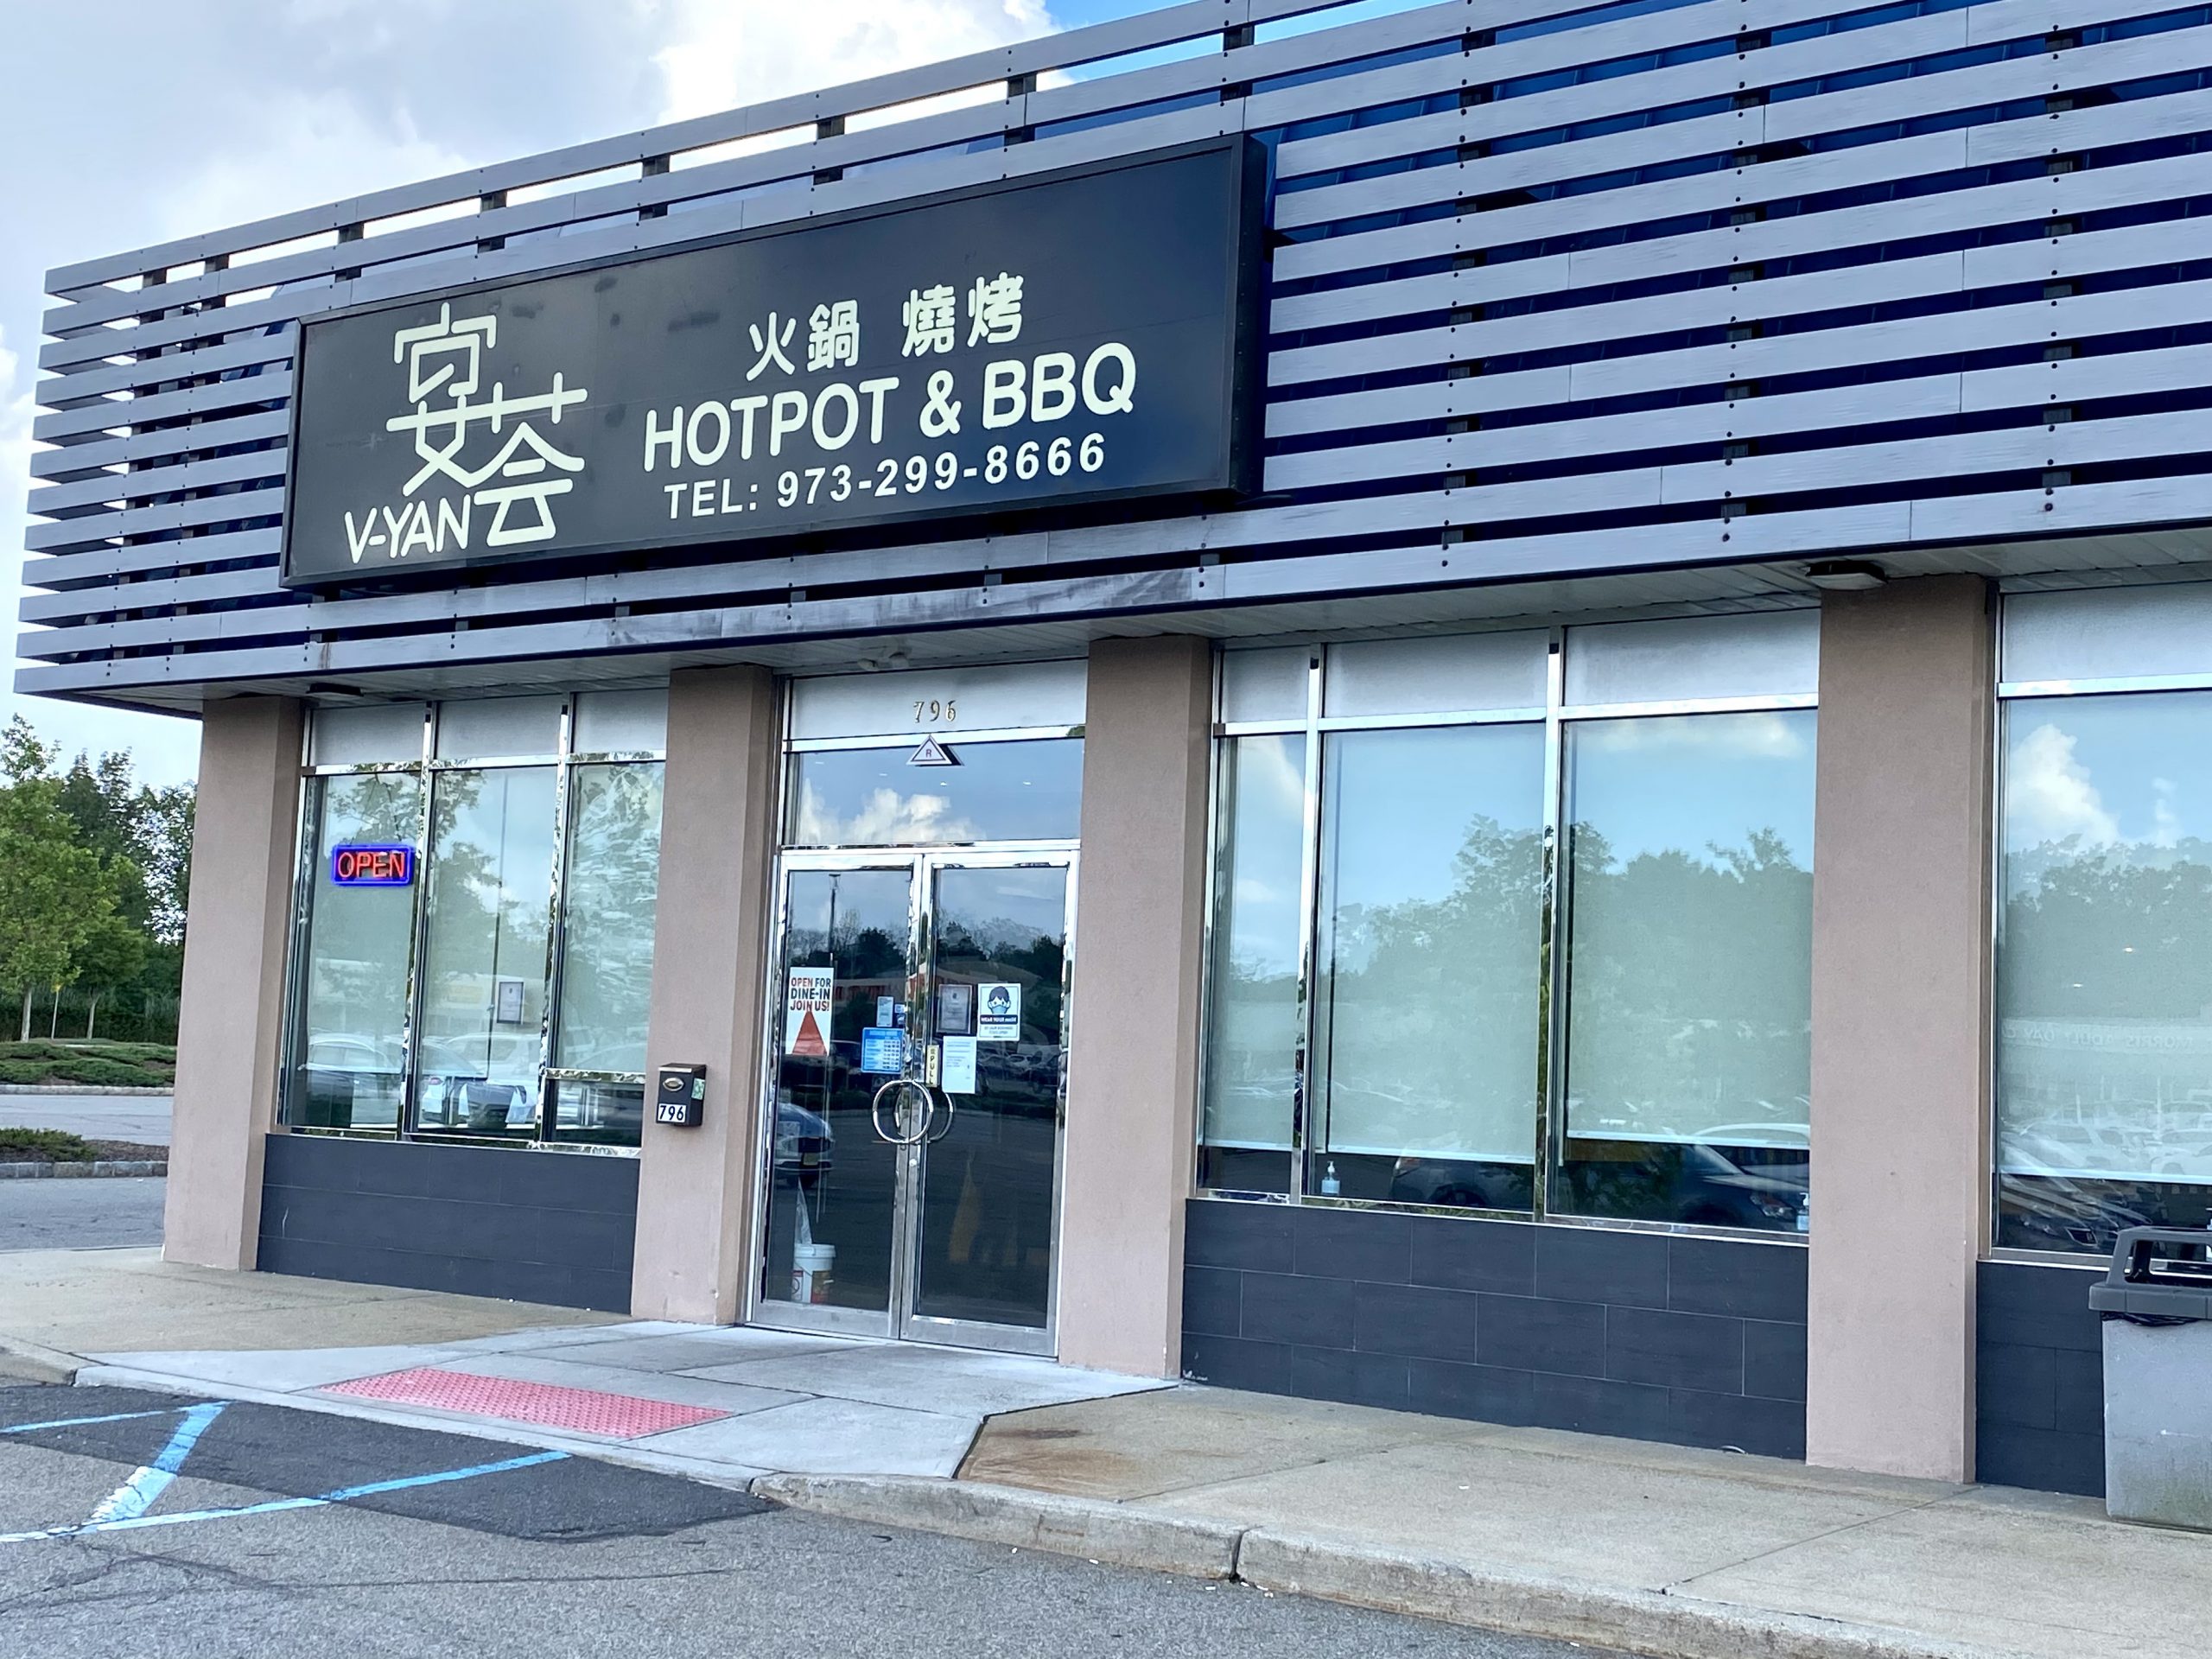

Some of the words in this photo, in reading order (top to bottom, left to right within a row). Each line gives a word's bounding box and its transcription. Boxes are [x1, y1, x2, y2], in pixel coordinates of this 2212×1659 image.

[747, 300, 860, 380] 火鍋
[901, 272, 1024, 358] 燒烤
[644, 378, 899, 471] HOTPOT
[919, 371, 962, 438] &
[982, 343, 1136, 430] BBQ
[664, 477, 758, 518] TEL:
[777, 433, 1104, 507] 973-299-8666
[345, 494, 471, 563] V-YAN
[913, 700, 957, 723] 796
[338, 851, 405, 878] OPEN
[791, 977, 814, 987] OPEN
[815, 977, 831, 988] FOR
[791, 988, 830, 1001] DINE-IN
[790, 1000, 813, 1011] JOIN
[815, 1001, 830, 1012] US!
[659, 1105, 683, 1121] 796
